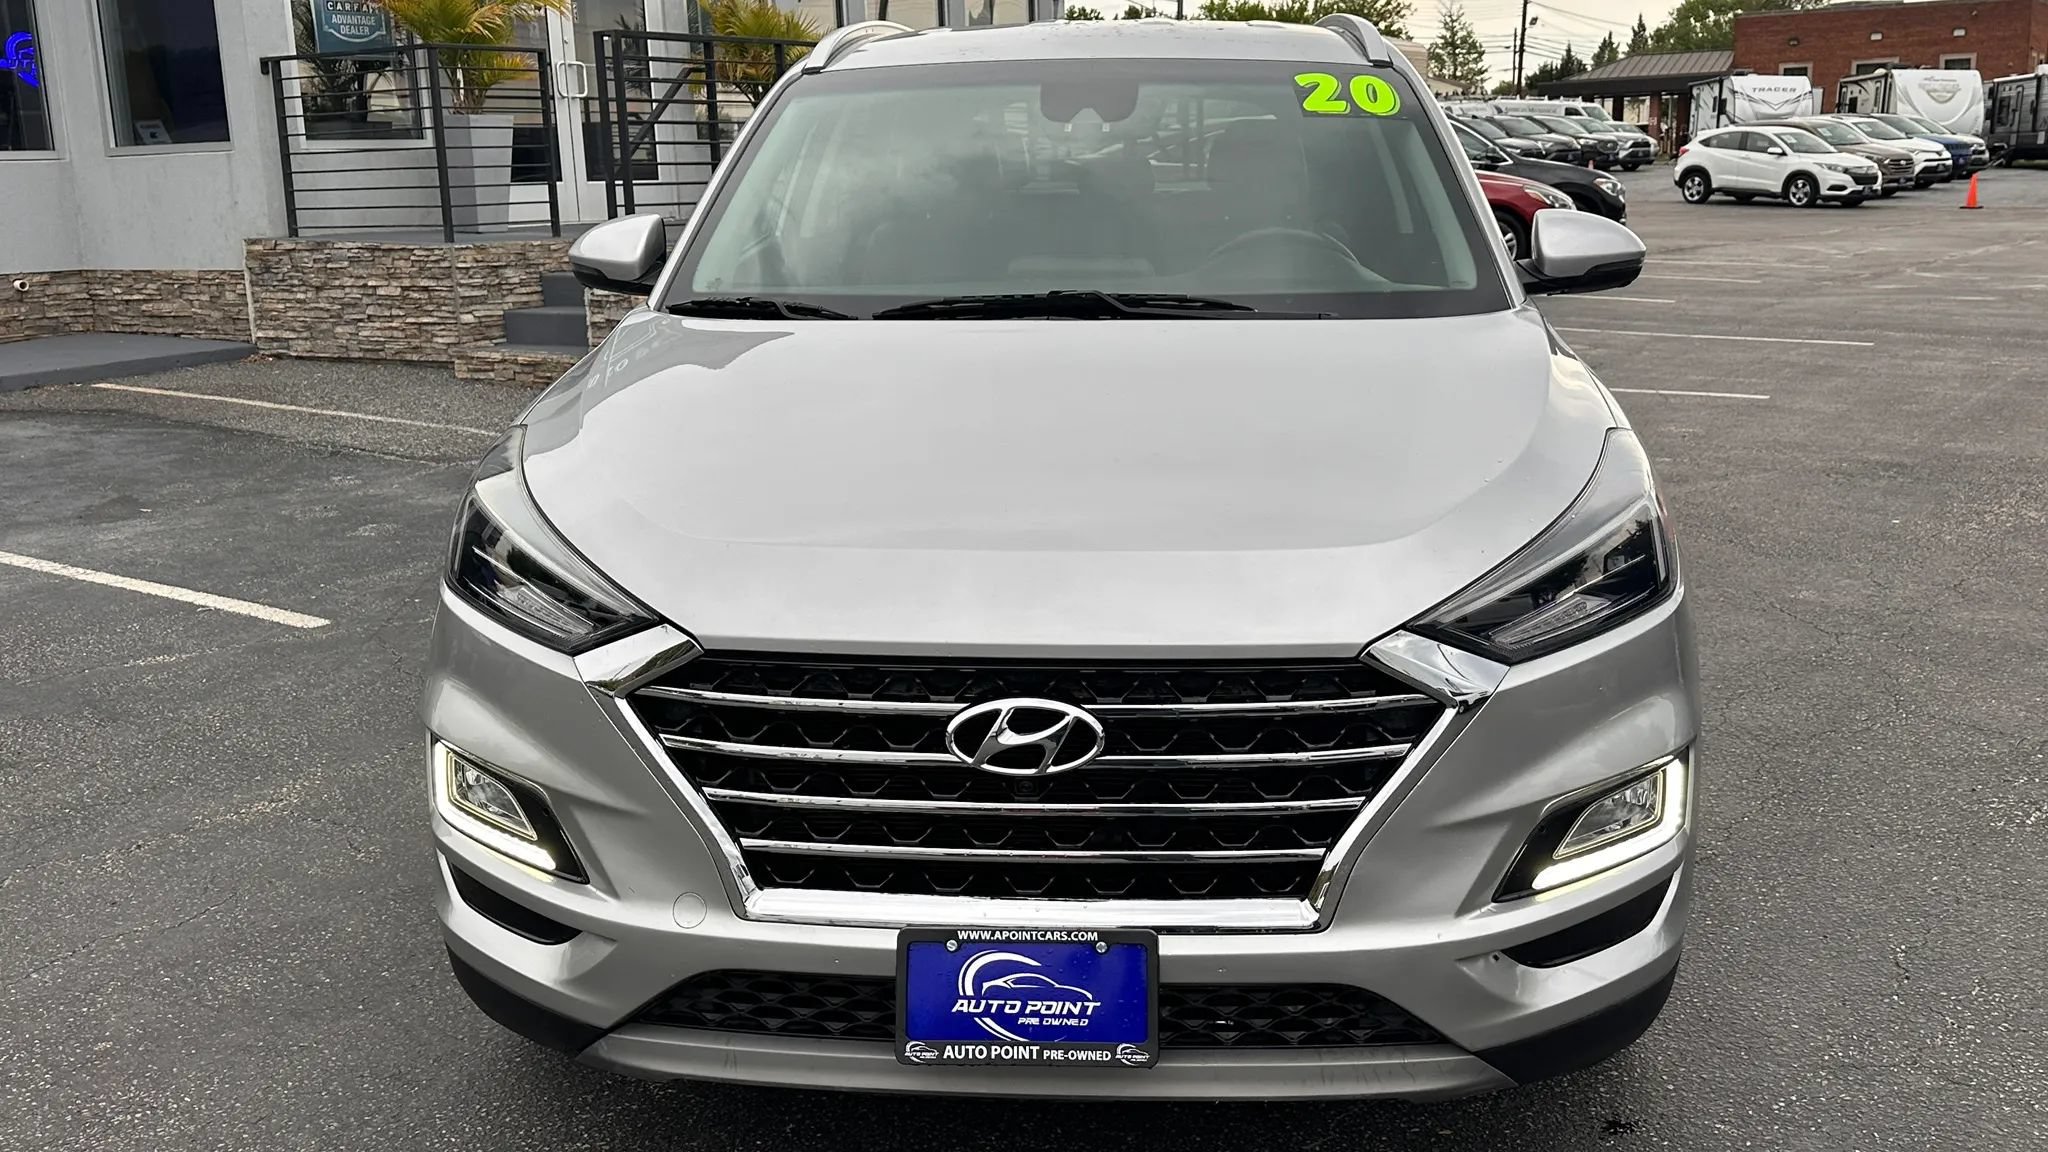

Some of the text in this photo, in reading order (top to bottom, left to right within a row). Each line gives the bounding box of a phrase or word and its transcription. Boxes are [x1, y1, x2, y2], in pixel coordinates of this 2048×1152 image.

[331, 14, 376, 25] ADVANTAGE
[340, 25, 370, 35] DEALER
[1294, 72, 1400, 116] 20
[957, 930, 1098, 941] WWW.APOINTCARS.COM
[951, 999, 1101, 1015] AUTO POINT
[1017, 1017, 1089, 1026] PRE OWNED
[943, 1045, 1111, 1061] AUTO POINT PRE-OWNED
